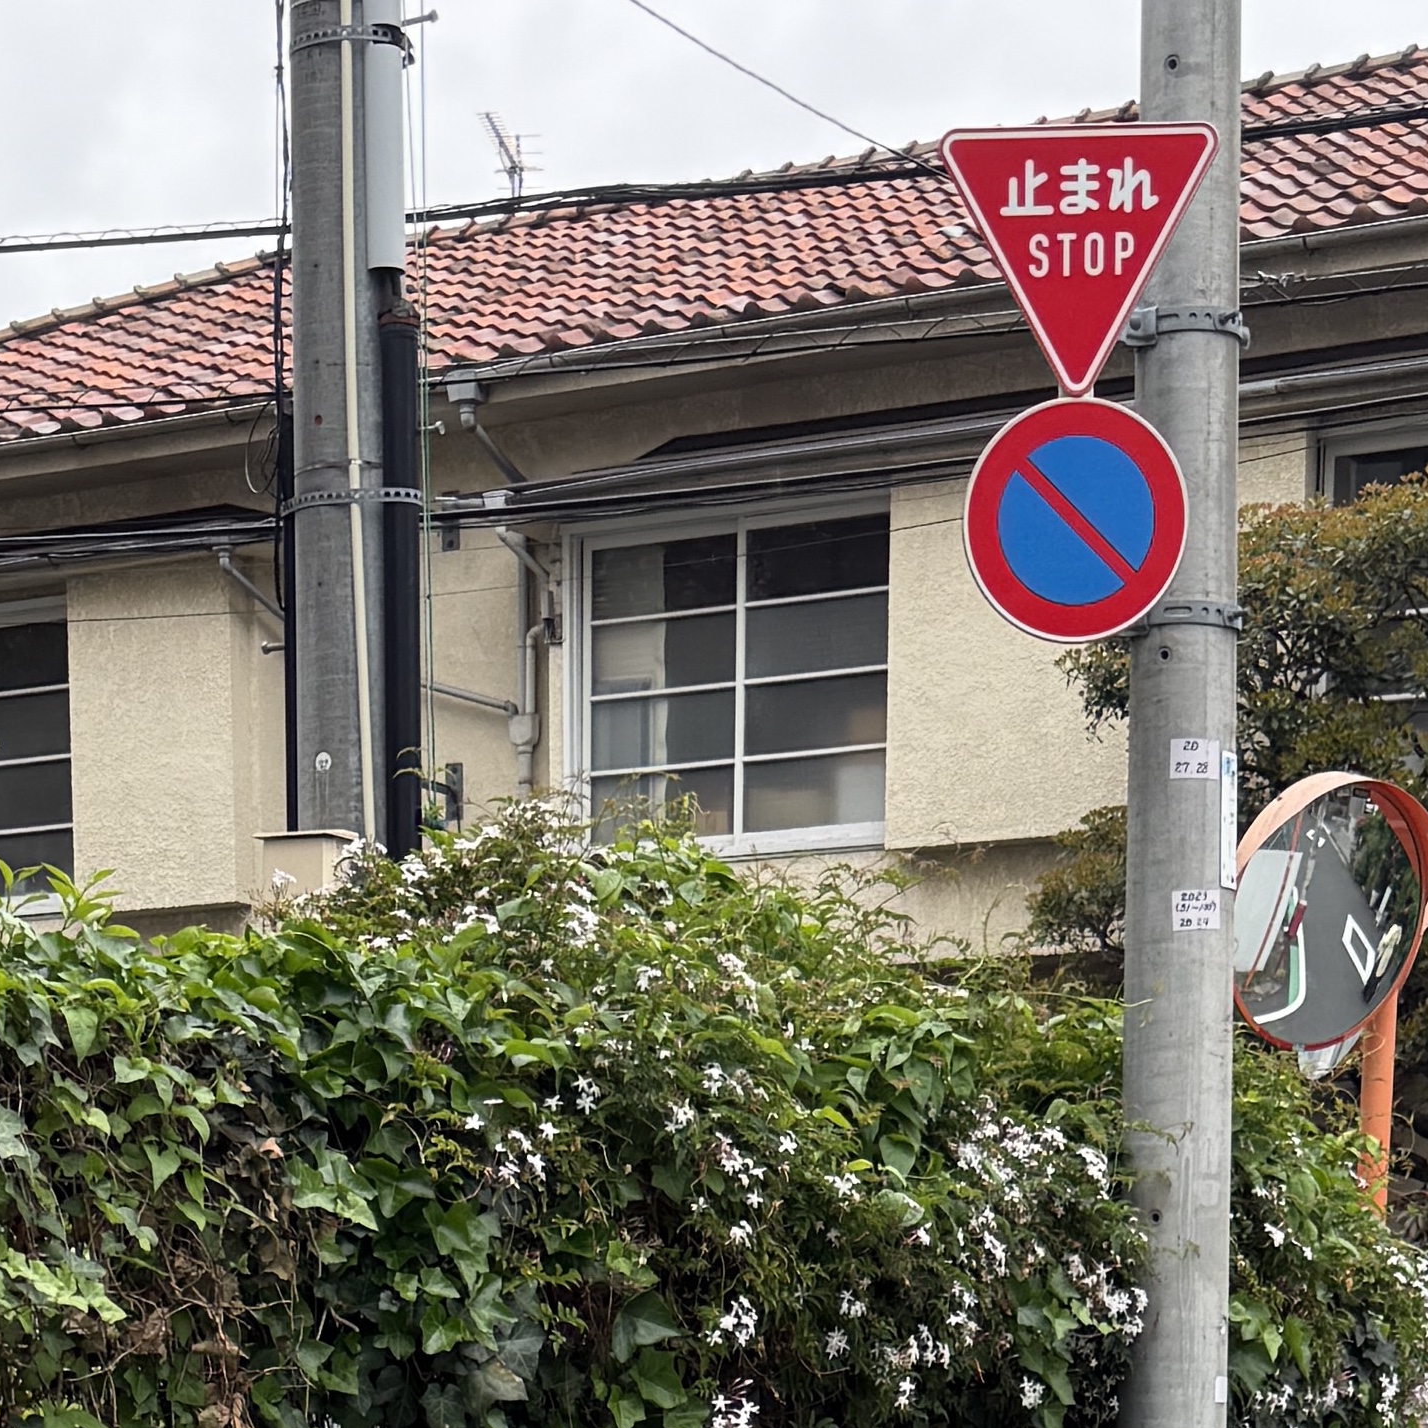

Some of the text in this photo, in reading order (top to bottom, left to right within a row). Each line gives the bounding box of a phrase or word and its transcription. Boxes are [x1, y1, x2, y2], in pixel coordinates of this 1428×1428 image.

[999, 156, 1159, 217] 止まれ
[1028, 231, 1135, 278] STOP
